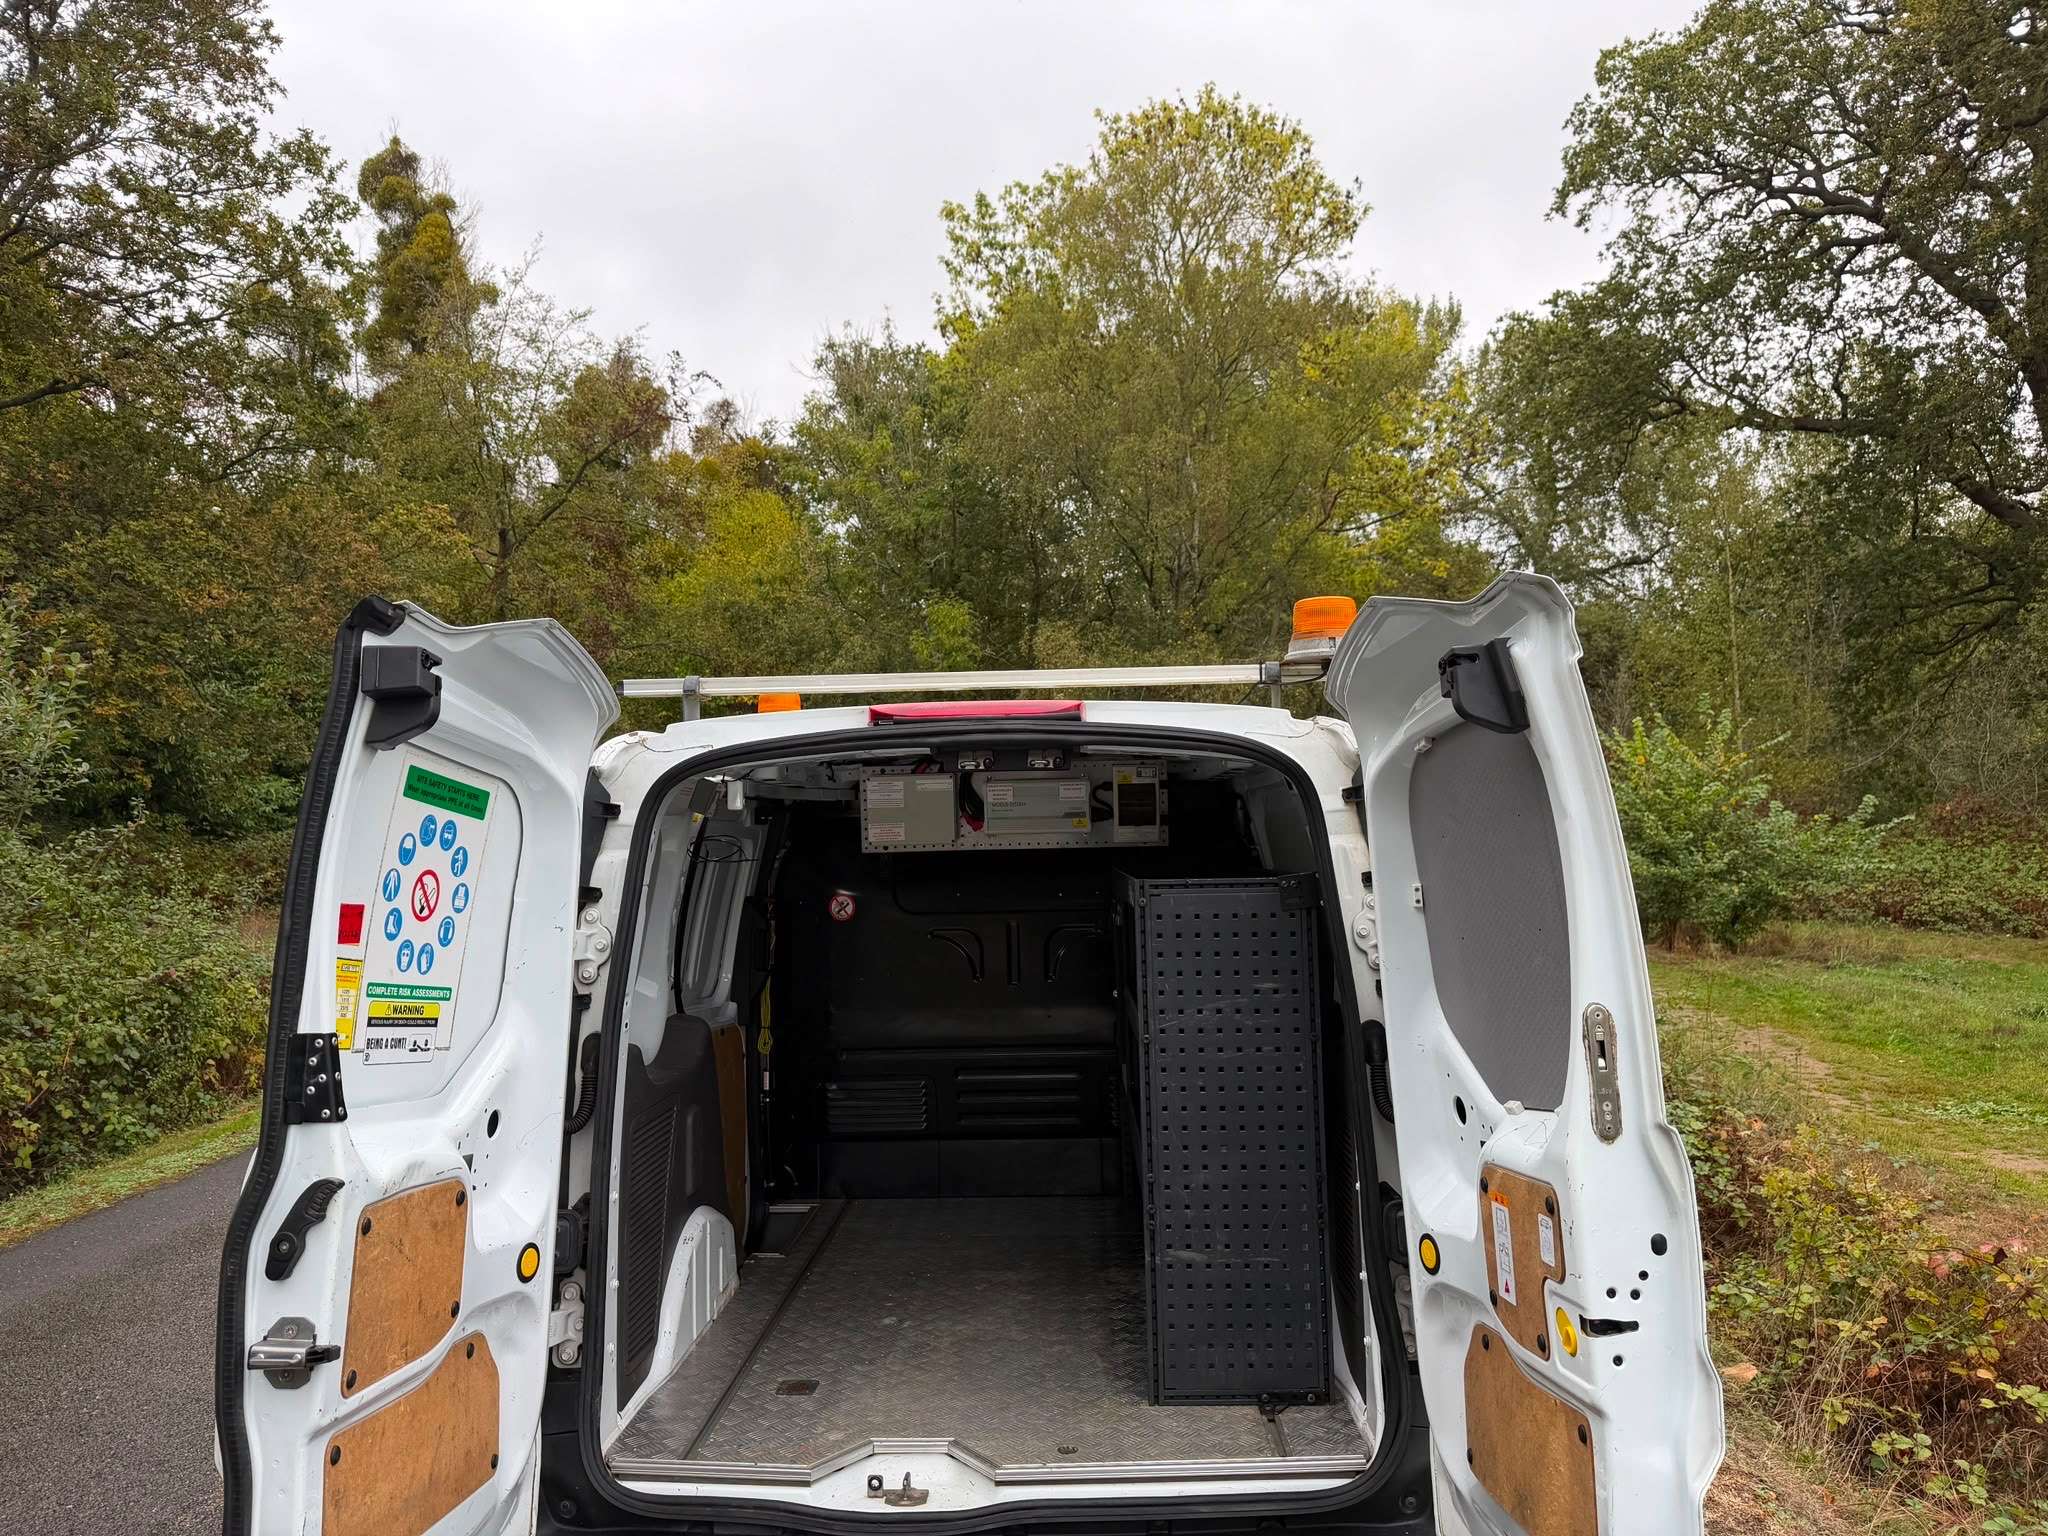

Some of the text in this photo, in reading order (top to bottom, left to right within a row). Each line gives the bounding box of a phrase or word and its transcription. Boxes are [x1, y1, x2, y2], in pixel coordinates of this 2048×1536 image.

[429, 779, 447, 790] SAFETY
[368, 986, 451, 999] COMPLETE RISK ASSESSMENTS
[392, 1004, 425, 1015] WARNING
[366, 1037, 384, 1050] BEING
[384, 1037, 389, 1050] A
